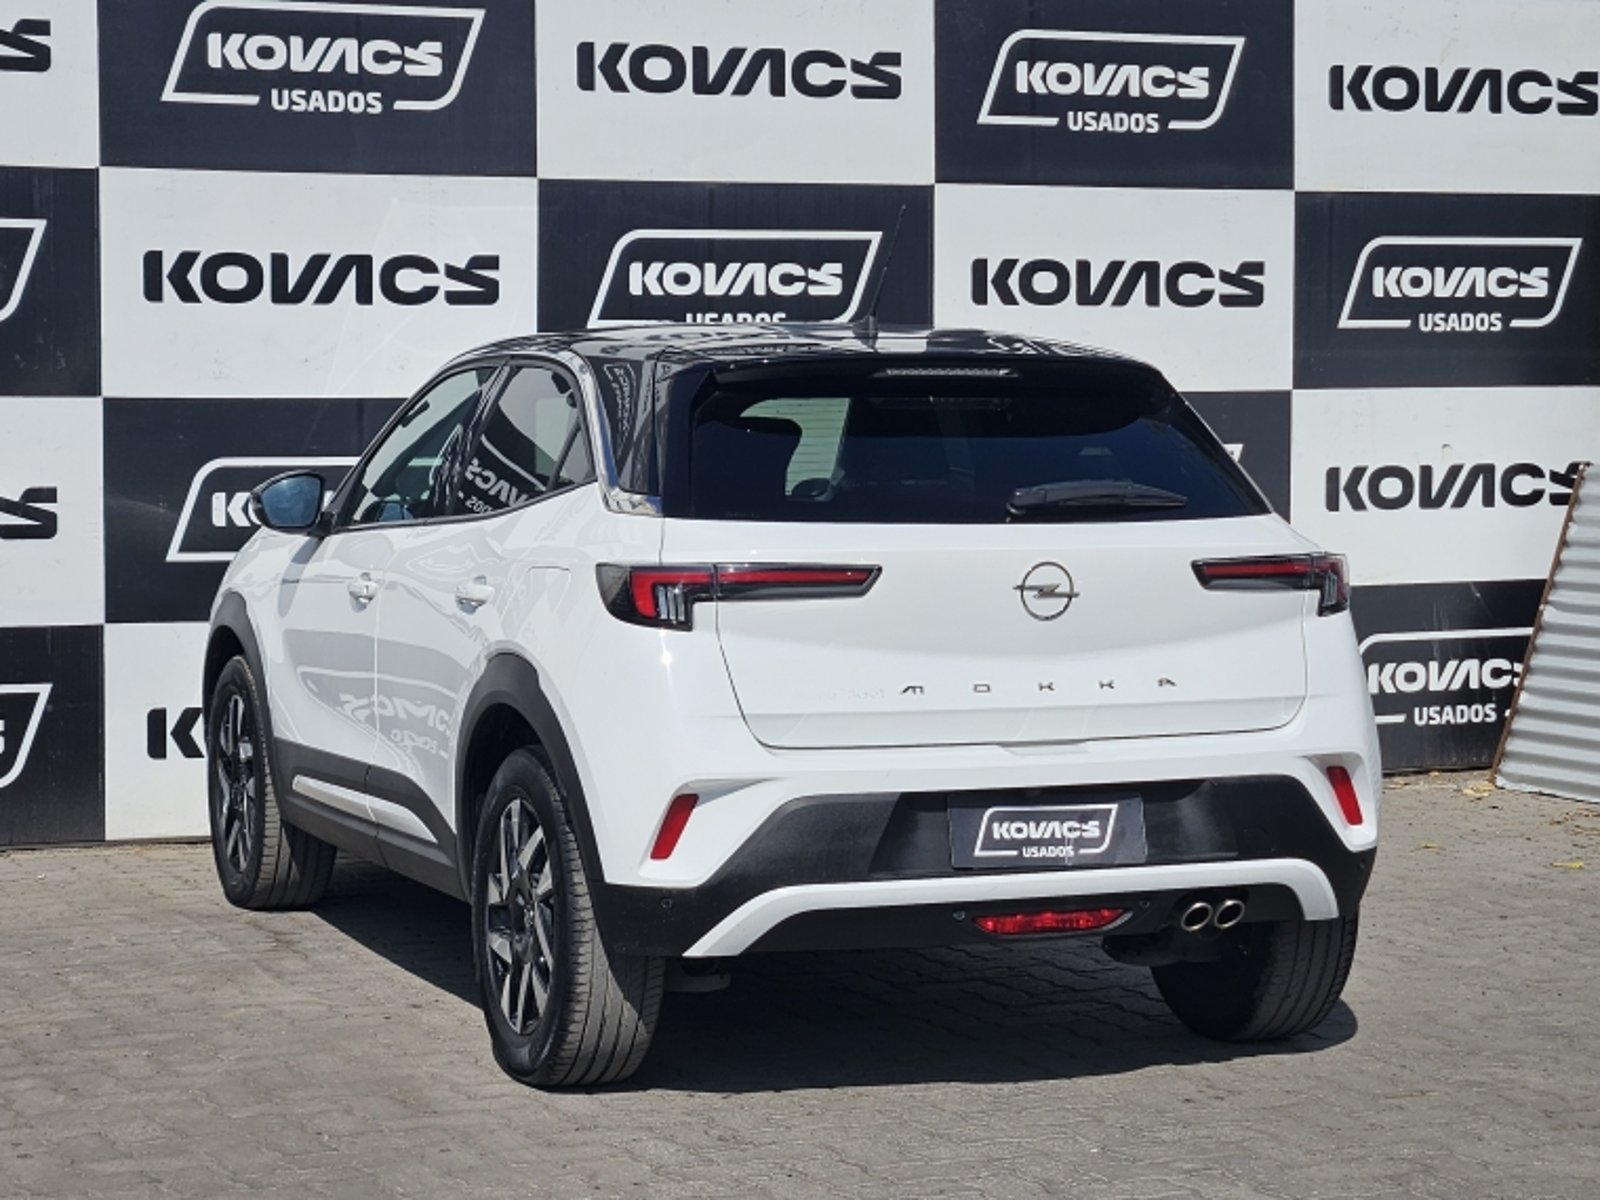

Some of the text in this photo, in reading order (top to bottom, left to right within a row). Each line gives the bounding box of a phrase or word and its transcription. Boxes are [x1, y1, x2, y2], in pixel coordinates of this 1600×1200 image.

[207, 33, 442, 76] KOVACS
[577, 42, 901, 99] KOVACS
[1016, 61, 1209, 98] KOVACS
[1329, 65, 1598, 116] KOVACS
[271, 88, 383, 114] USADOS
[1067, 111, 1160, 133] USADOS
[143, 250, 500, 305] KOVACS
[629, 262, 843, 295] KOVACS
[972, 258, 1265, 307] KOVACS
[1372, 267, 1549, 298] KOVACS
[1418, 313, 1502, 332] USADOS
[1367, 658, 1522, 694] KOVAC
[1414, 703, 1497, 726] USADOS
[992, 820, 1101, 840] KOVACS
[1022, 846, 1075, 858] USADOS
